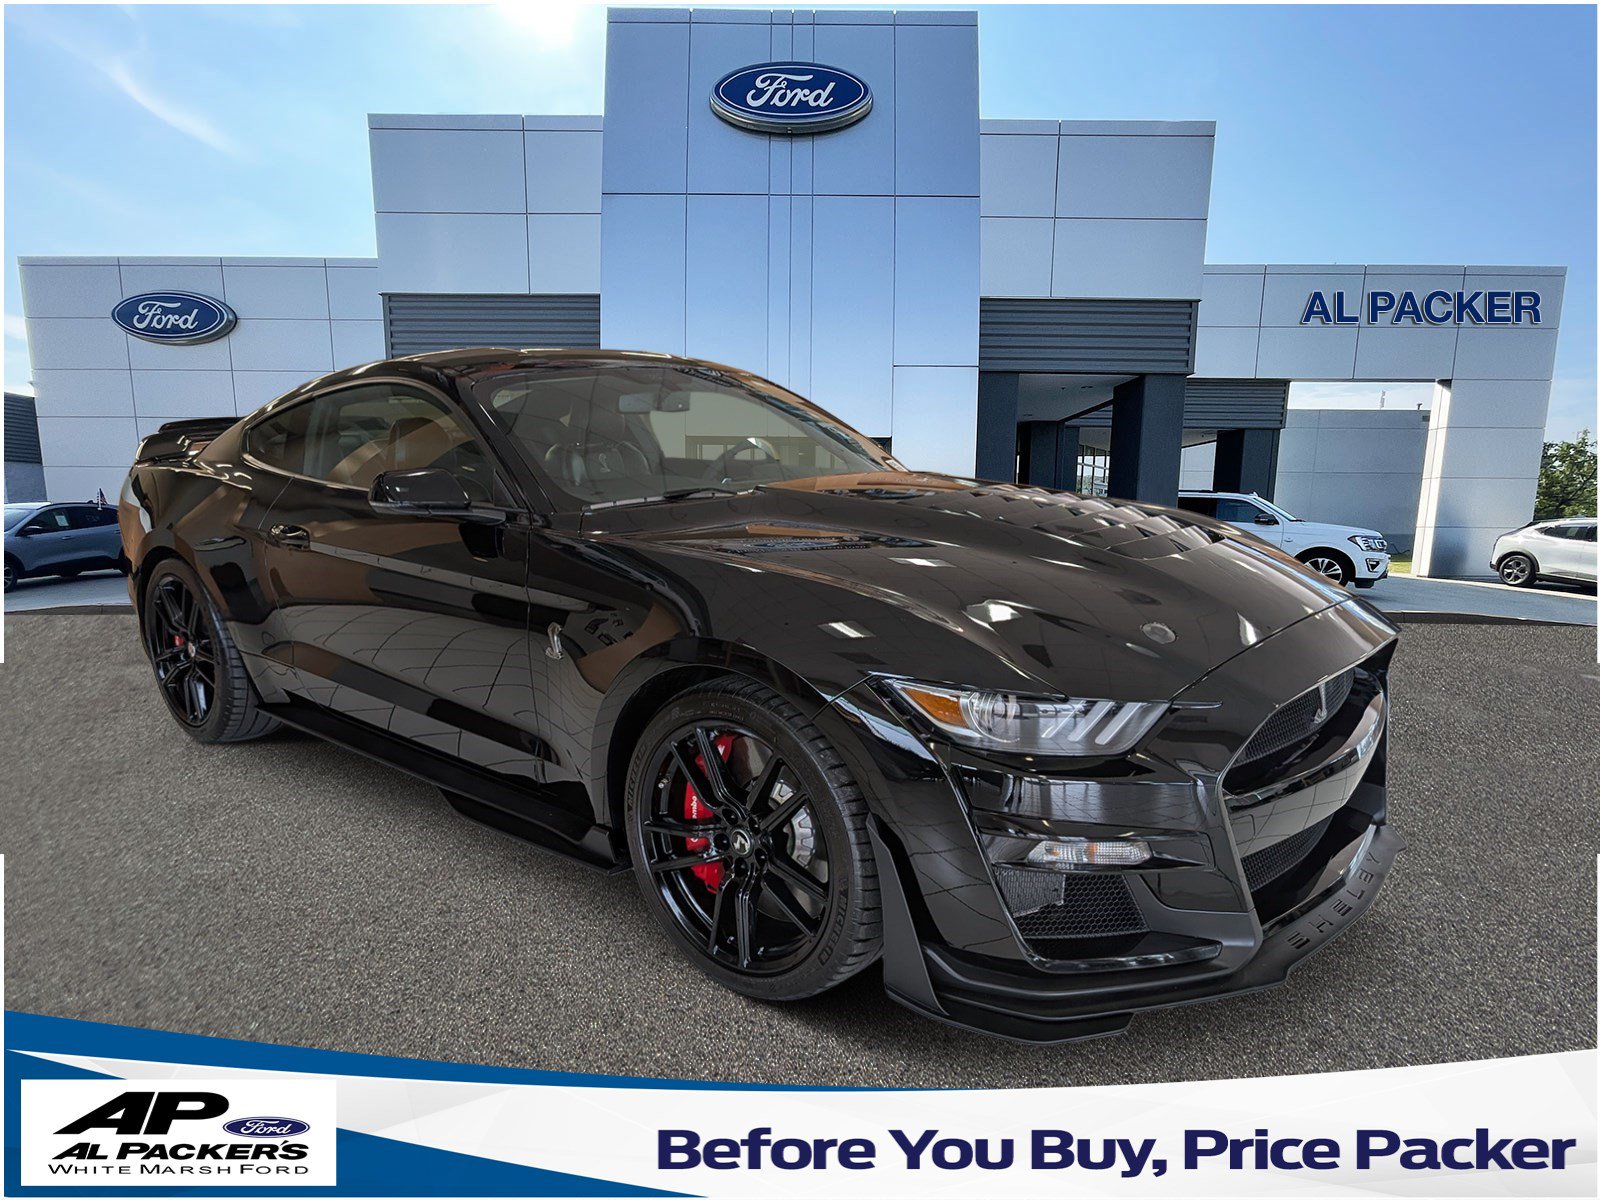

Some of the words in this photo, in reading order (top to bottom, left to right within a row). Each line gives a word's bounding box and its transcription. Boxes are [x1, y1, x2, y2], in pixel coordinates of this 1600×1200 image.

[746, 73, 836, 108] Ford
[133, 301, 199, 329] Ford
[1302, 290, 1360, 324] AL
[1368, 290, 1542, 325] PACKER
[1286, 851, 1382, 950] SHELBY
